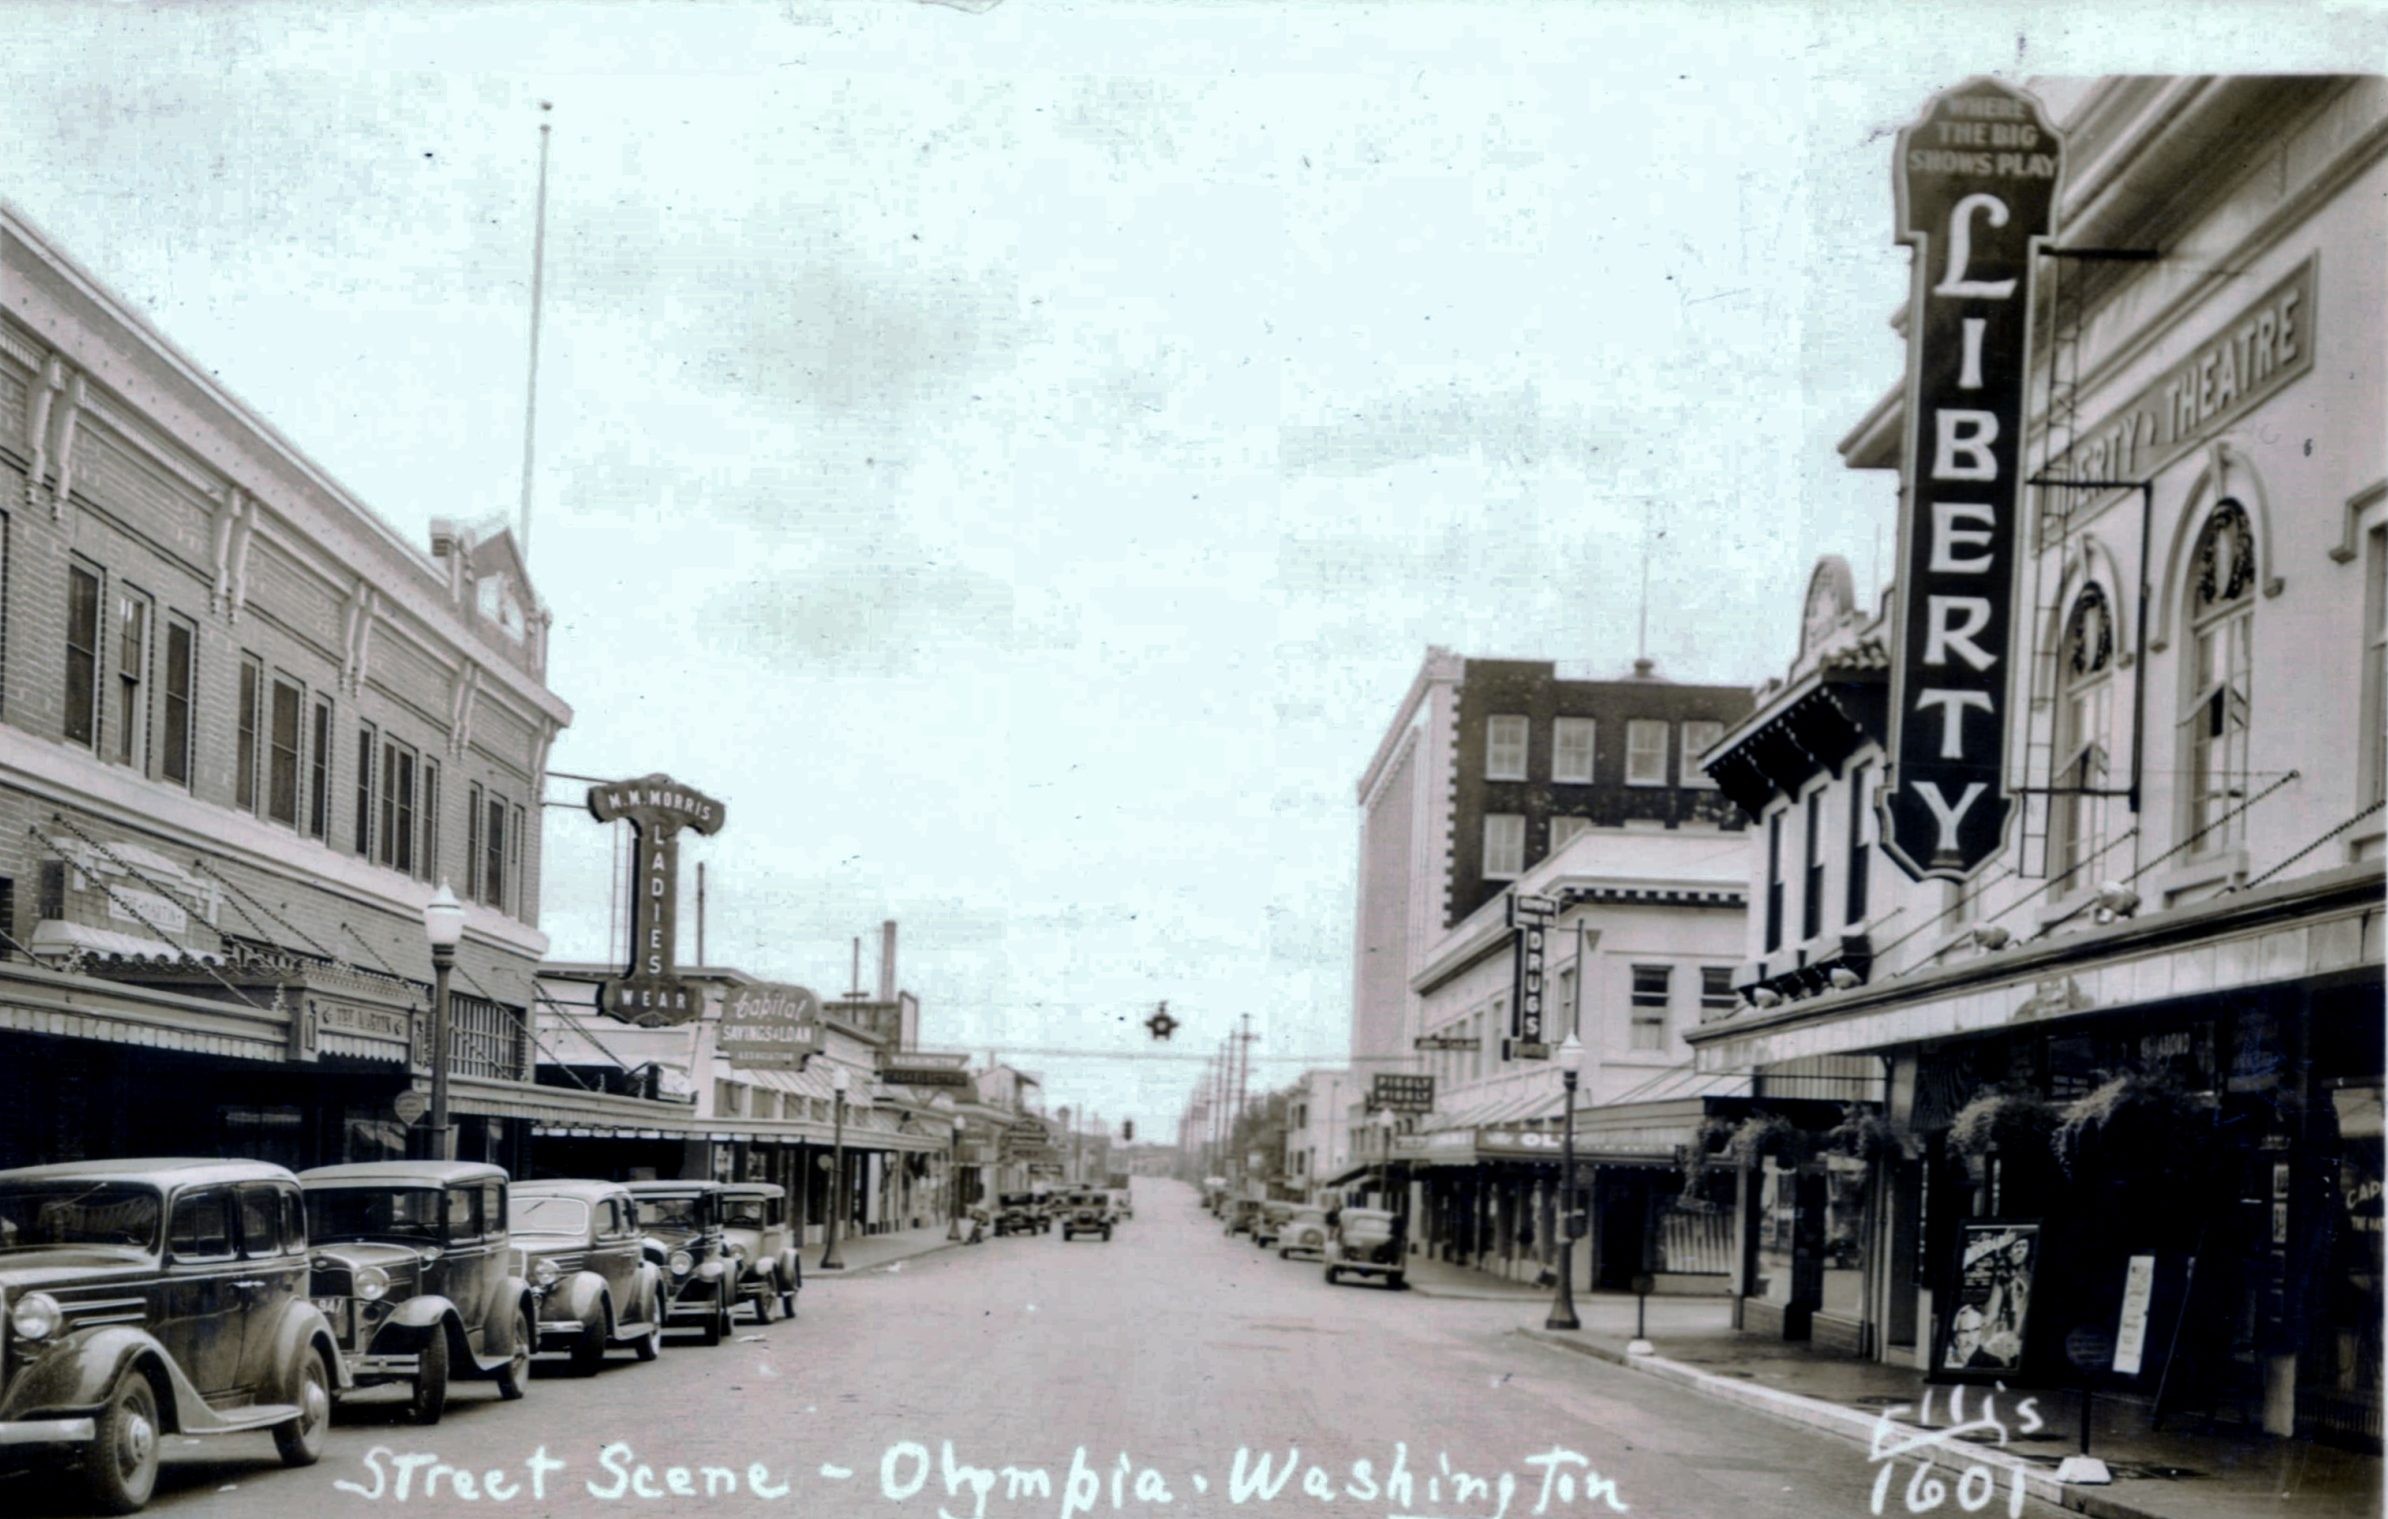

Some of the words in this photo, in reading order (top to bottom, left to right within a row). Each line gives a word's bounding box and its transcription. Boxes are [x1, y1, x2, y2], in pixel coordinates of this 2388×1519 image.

[1938, 120, 1987, 145] THE
[1992, 122, 2039, 147] BIG
[1909, 150, 1993, 176] SHOWS
[1997, 152, 2057, 177] PLAY
[2165, 287, 2300, 443] THEATRE
[1911, 193, 2018, 851] LIBERTY
[648, 824, 665, 974] LADIES
[1525, 930, 1543, 1035] DRUGS
[622, 989, 686, 1009] WEAR
[733, 991, 807, 1021] Capital
[1379, 1077, 1430, 1088] PIGGLY
